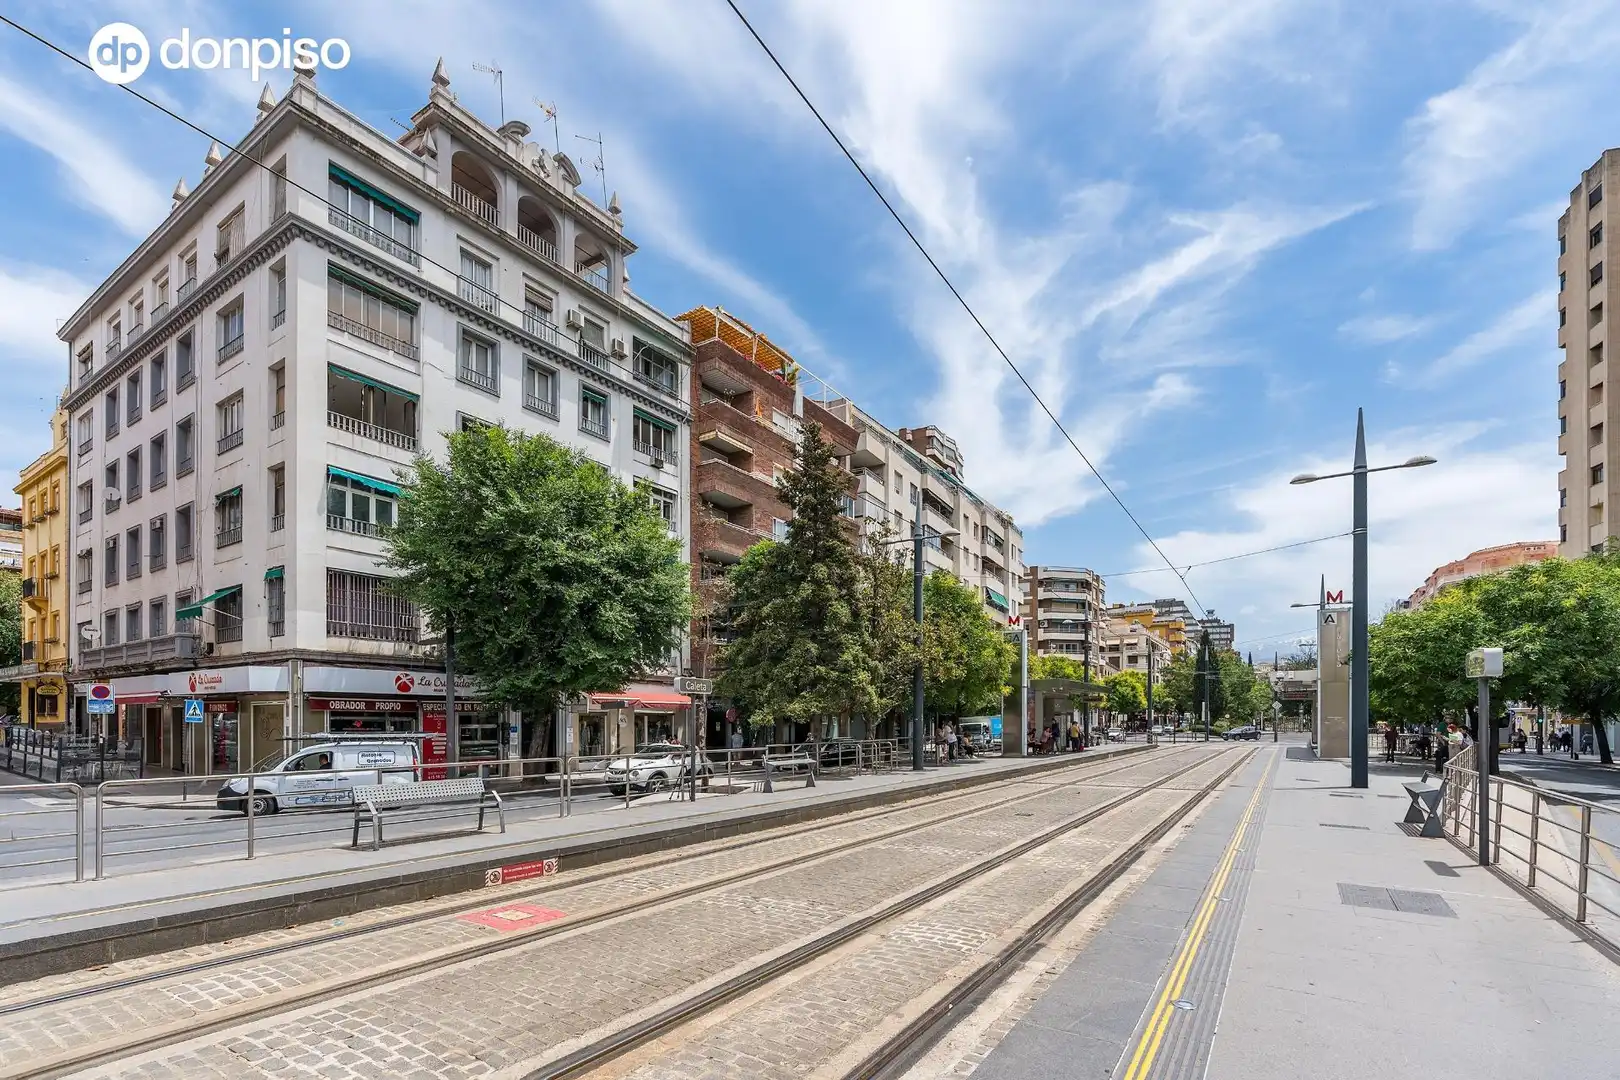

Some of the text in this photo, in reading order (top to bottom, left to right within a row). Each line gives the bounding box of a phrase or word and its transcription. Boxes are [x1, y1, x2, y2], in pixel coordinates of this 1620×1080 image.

[1326, 589, 1343, 604] M
[1008, 615, 1020, 627] M
[417, 675, 471, 689] La Cruada
[685, 680, 707, 691] Caleta
[329, 700, 401, 711] OBRADOR PROPIO
[464, 703, 472, 712] EN
